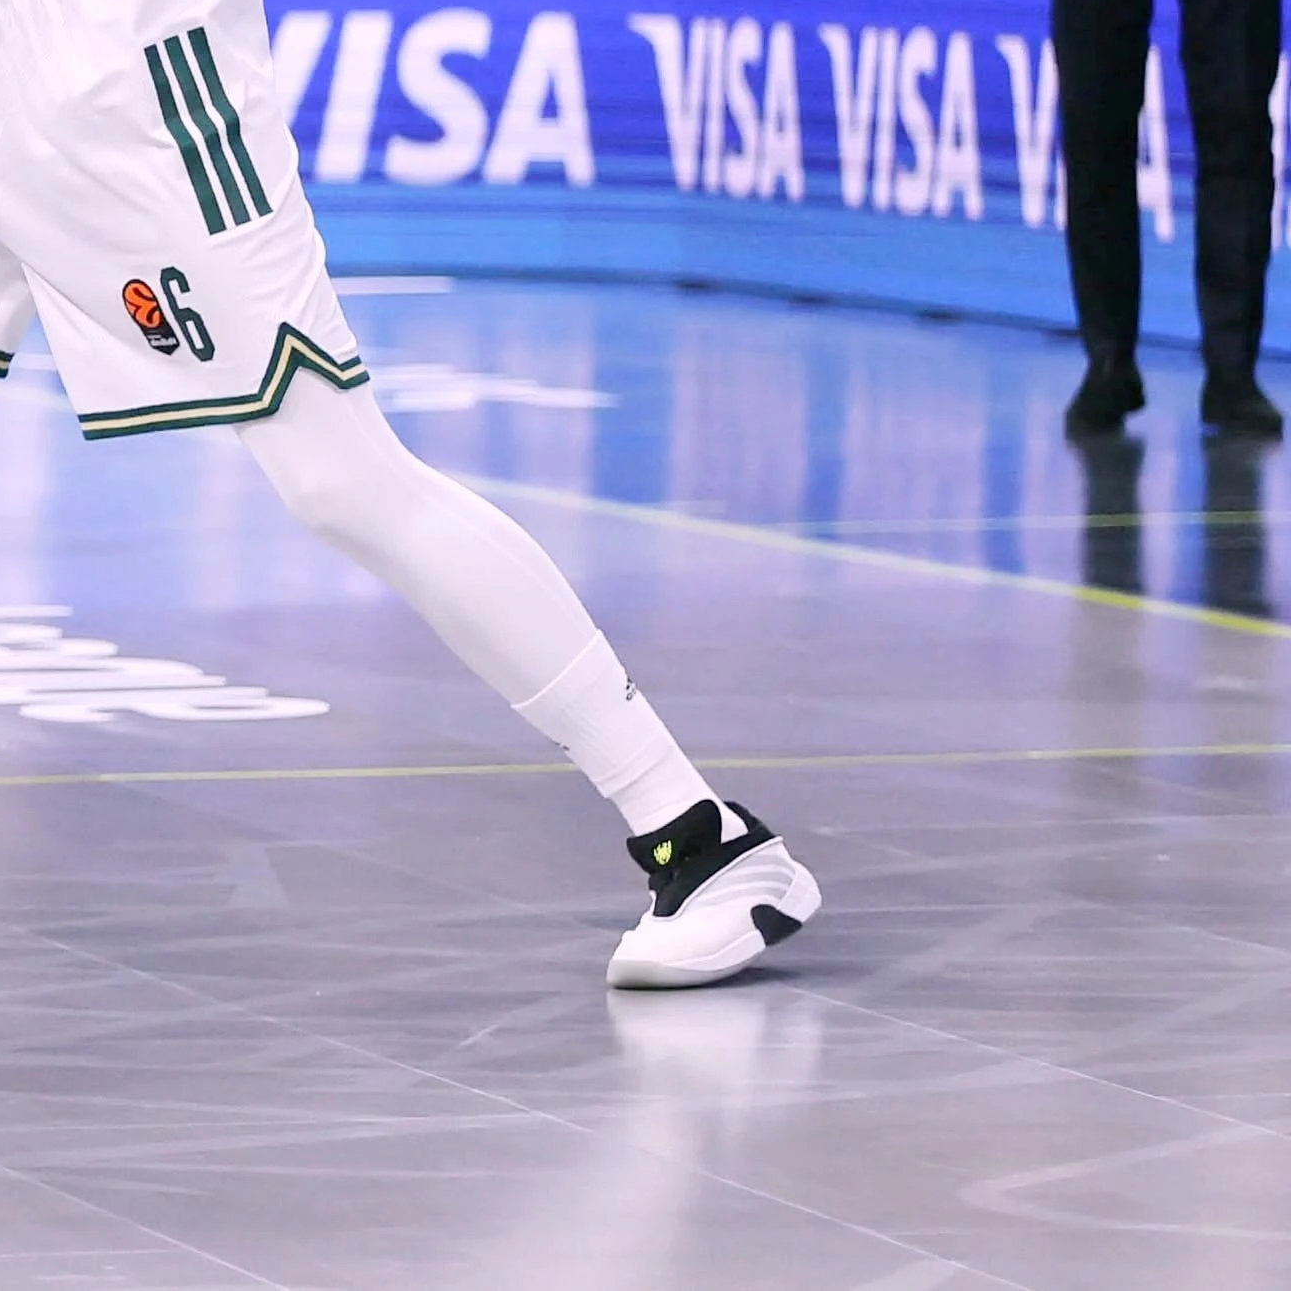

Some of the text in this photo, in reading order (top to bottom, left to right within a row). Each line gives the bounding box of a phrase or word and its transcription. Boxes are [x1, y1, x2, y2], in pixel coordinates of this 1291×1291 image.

[629, 12, 806, 201] VISA
[820, 24, 985, 221] VISA
[159, 265, 216, 363] 6
